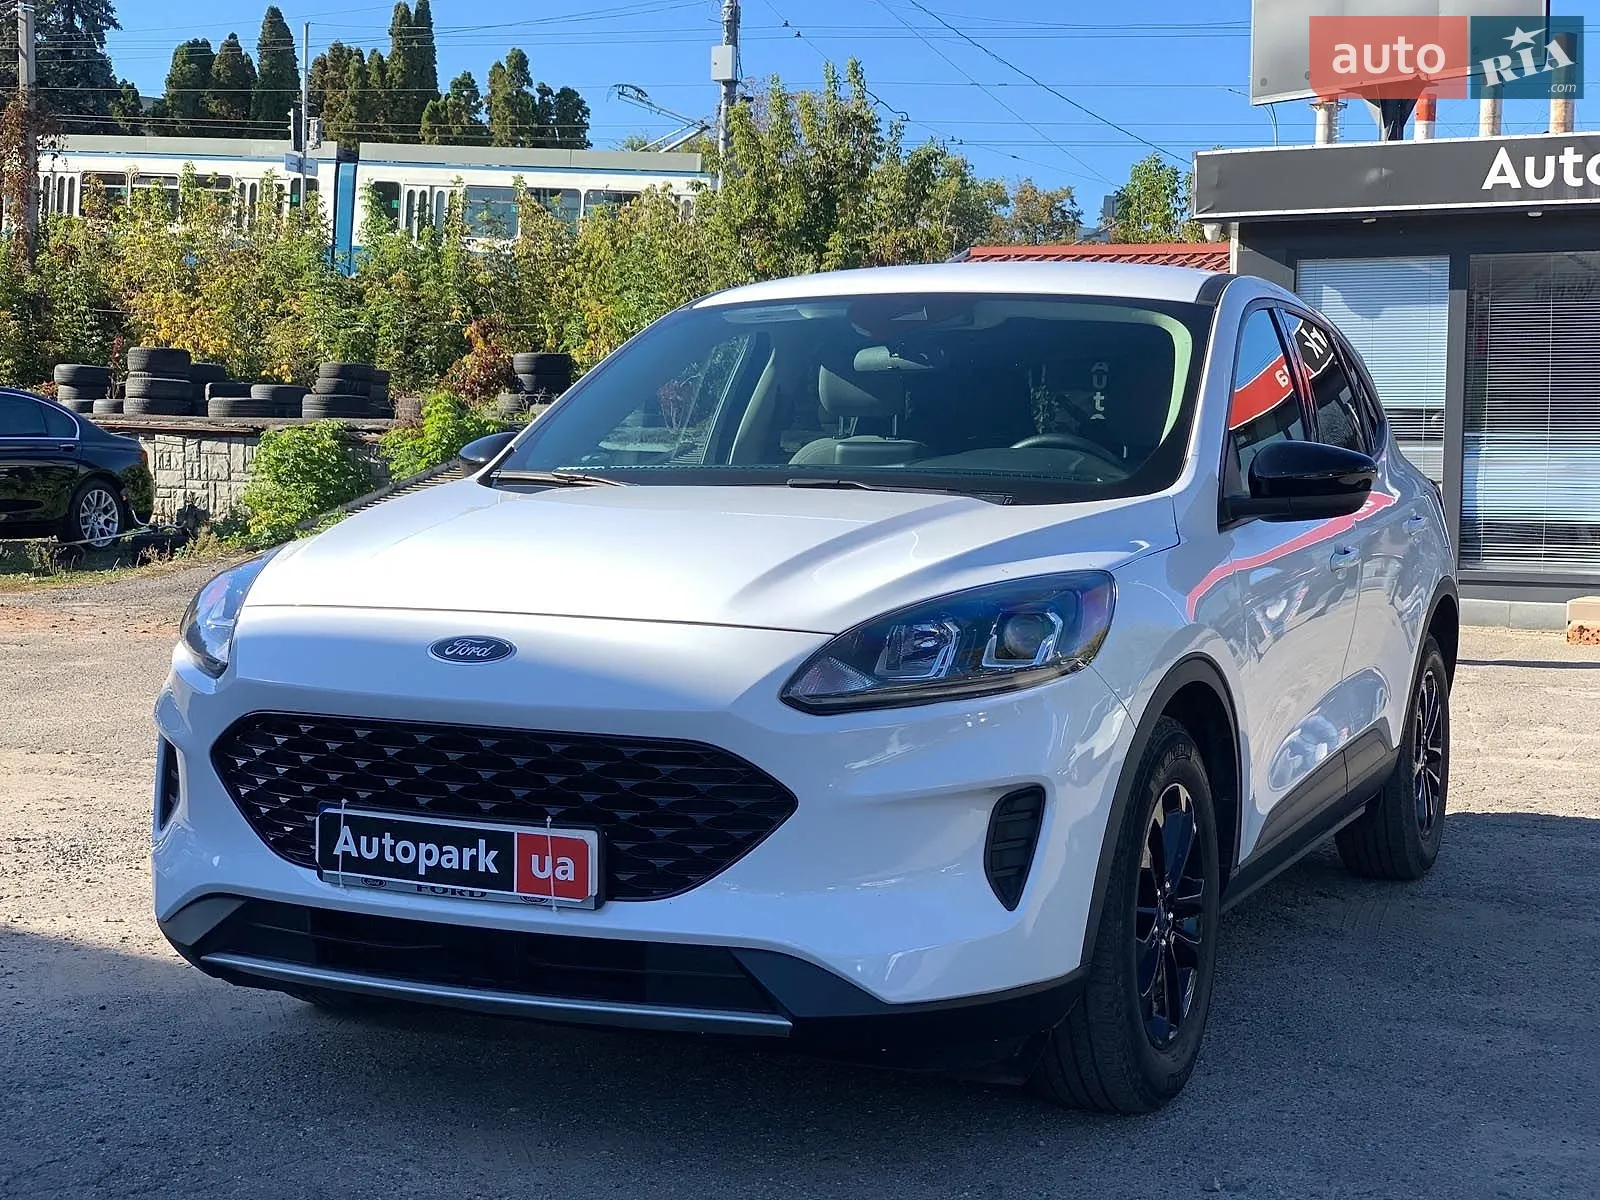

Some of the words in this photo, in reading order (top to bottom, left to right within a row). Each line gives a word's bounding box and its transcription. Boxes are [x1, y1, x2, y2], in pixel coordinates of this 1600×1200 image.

[444, 638, 496, 657] Ford
[333, 826, 499, 875] Autopark
[531, 854, 575, 881] ua
